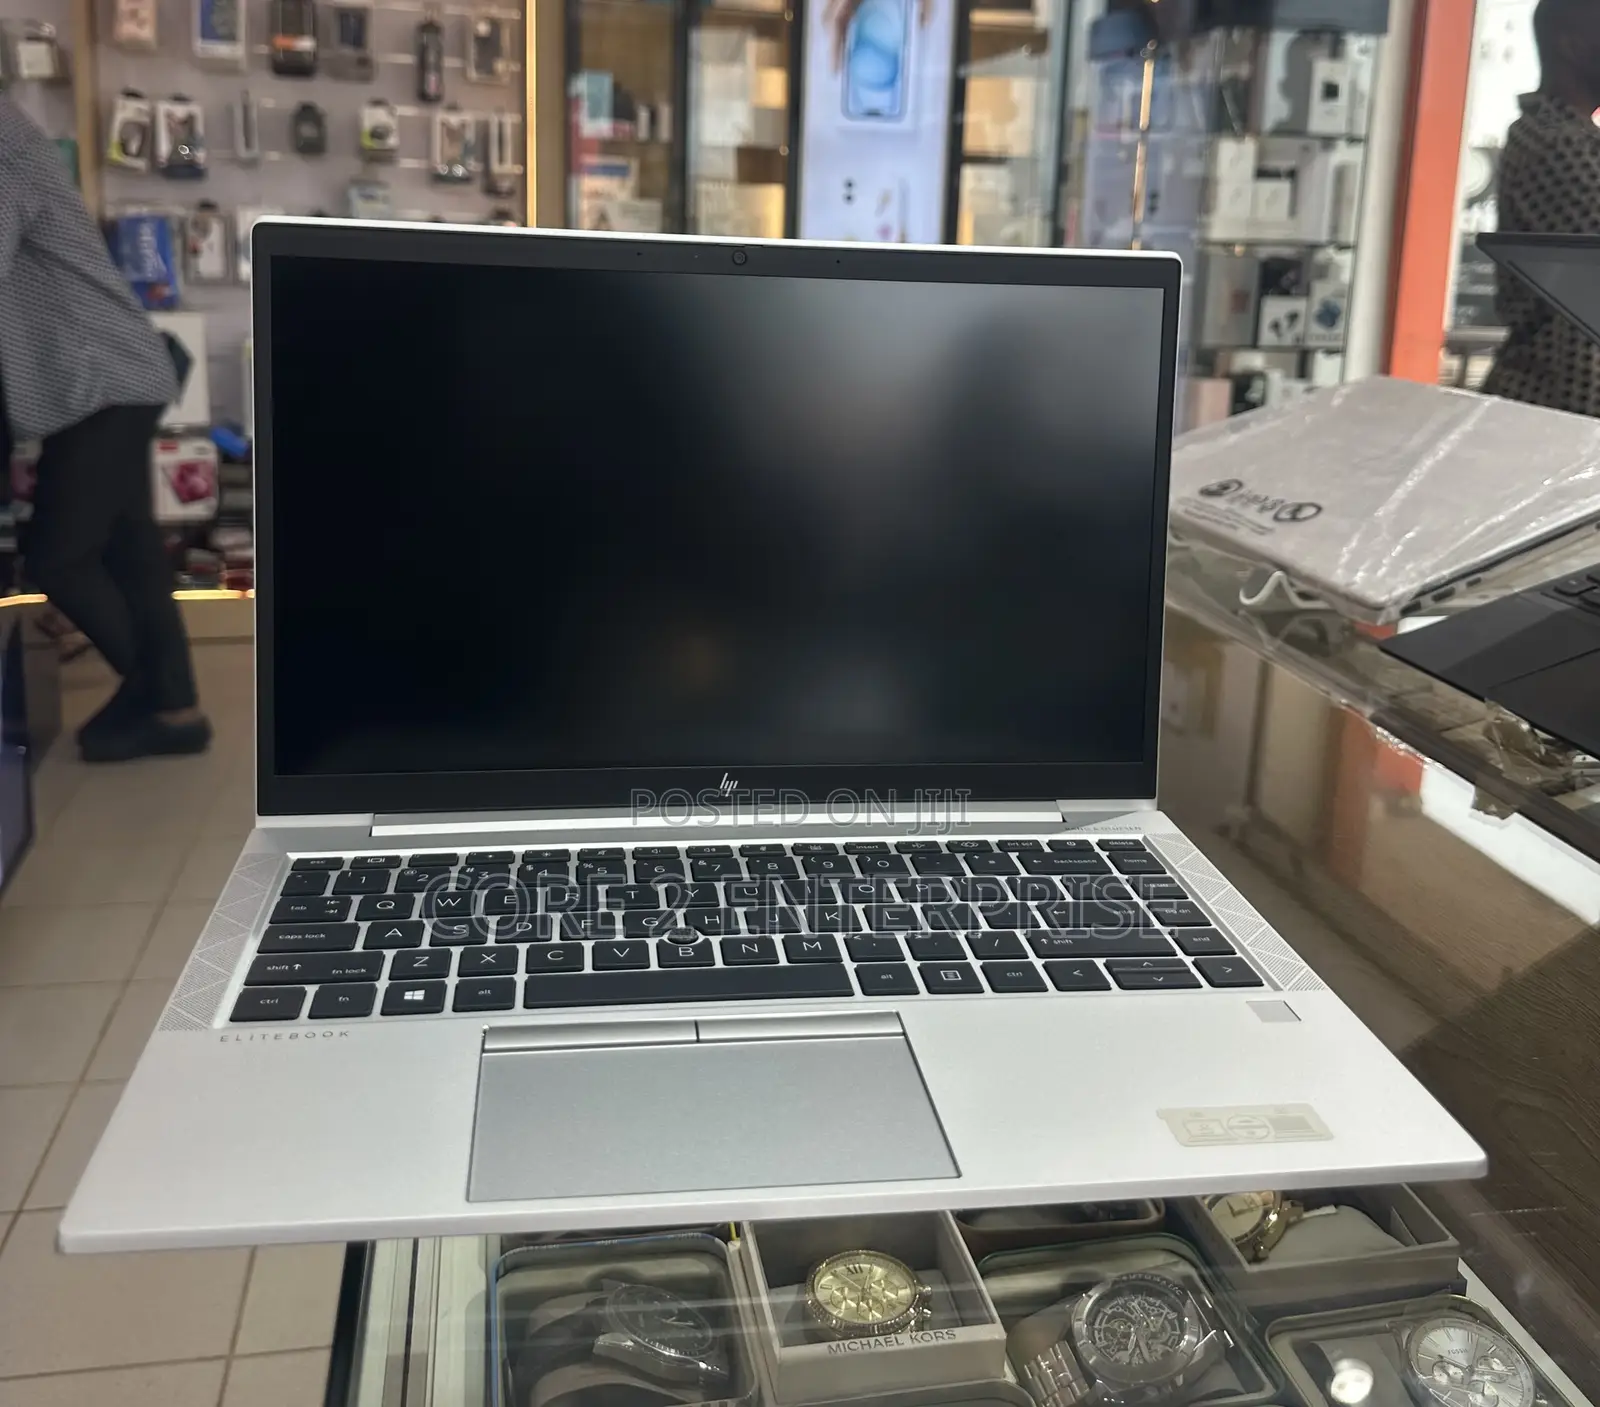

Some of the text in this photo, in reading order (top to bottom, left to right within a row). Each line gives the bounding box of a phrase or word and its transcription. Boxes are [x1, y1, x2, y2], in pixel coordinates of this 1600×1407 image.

[653, 865, 666, 873] 6
[711, 864, 721, 872] 7
[766, 862, 779, 870] 8
[822, 861, 834, 869] 9
[477, 871, 490, 879] 3
[537, 868, 549, 877] 4
[597, 867, 608, 875] 5
[360, 876, 367, 884] 1
[417, 873, 430, 882] 2
[684, 888, 700, 898] Y
[743, 887, 759, 896] U
[857, 884, 876, 894] O
[915, 883, 930, 893] P
[565, 892, 580, 901] R
[625, 890, 640, 899] T
[376, 900, 396, 910] Q
[437, 897, 462, 907] W
[503, 895, 518, 905] E
[704, 915, 721, 925] H
[768, 913, 779, 923] J
[824, 912, 841, 921] K
[884, 911, 900, 920] L
[516, 922, 533, 932] D
[581, 919, 595, 929] F
[642, 917, 659, 927] G
[384, 927, 403, 938] A
[452, 924, 468, 935] S
[278, 932, 327, 941] caps lock
[741, 943, 759, 954] N
[802, 941, 822, 951] M
[546, 950, 564, 960] C
[613, 947, 630, 958] V
[678, 946, 695, 957] B
[412, 956, 430, 967] Z
[480, 952, 497, 964] X
[266, 963, 290, 971] shift
[219, 1030, 350, 1043] ELITEBOOK
[826, 1328, 957, 1355] MICHAEL KORS
